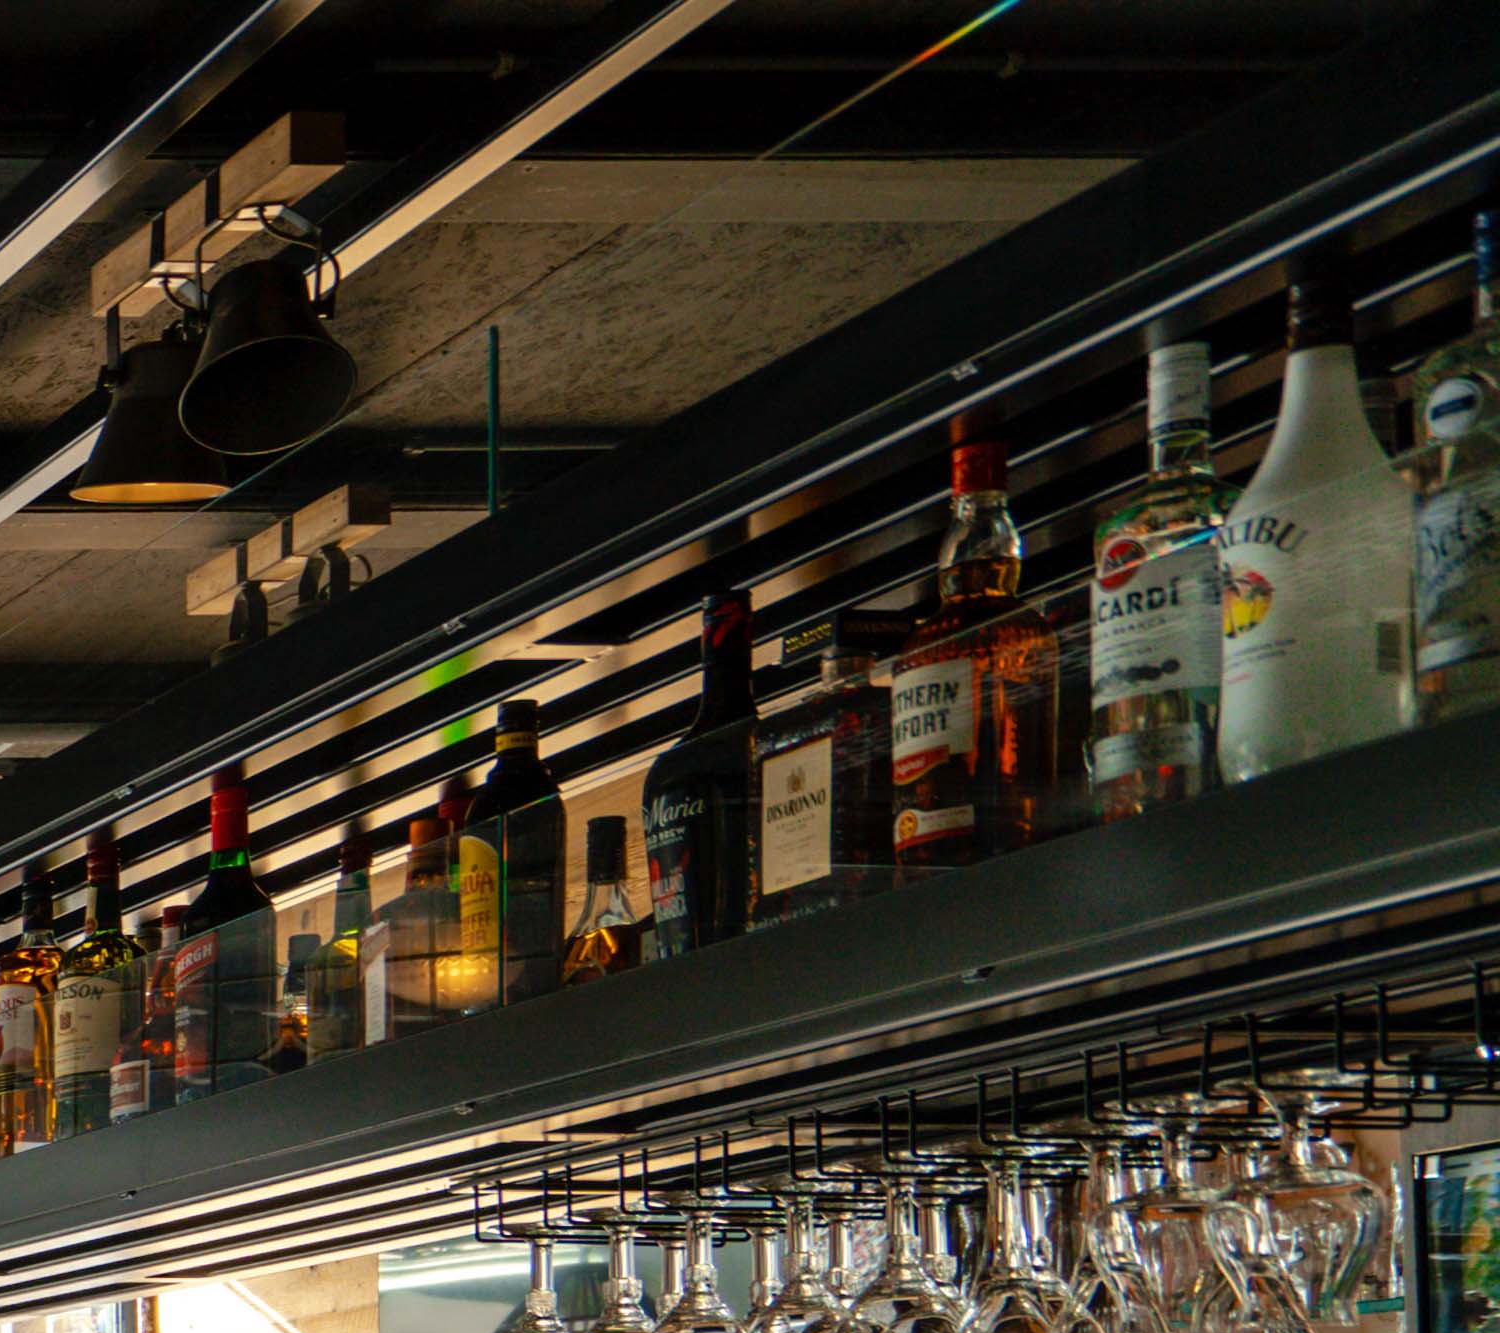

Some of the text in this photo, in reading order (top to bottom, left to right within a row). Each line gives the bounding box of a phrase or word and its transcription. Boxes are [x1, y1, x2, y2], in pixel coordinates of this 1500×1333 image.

[1096, 576, 1180, 624] CARDÍ
[896, 680, 959, 712] THERN
[645, 794, 706, 832] Maria
[766, 788, 826, 824] DISARONNO
[57, 984, 105, 1001] ESON
